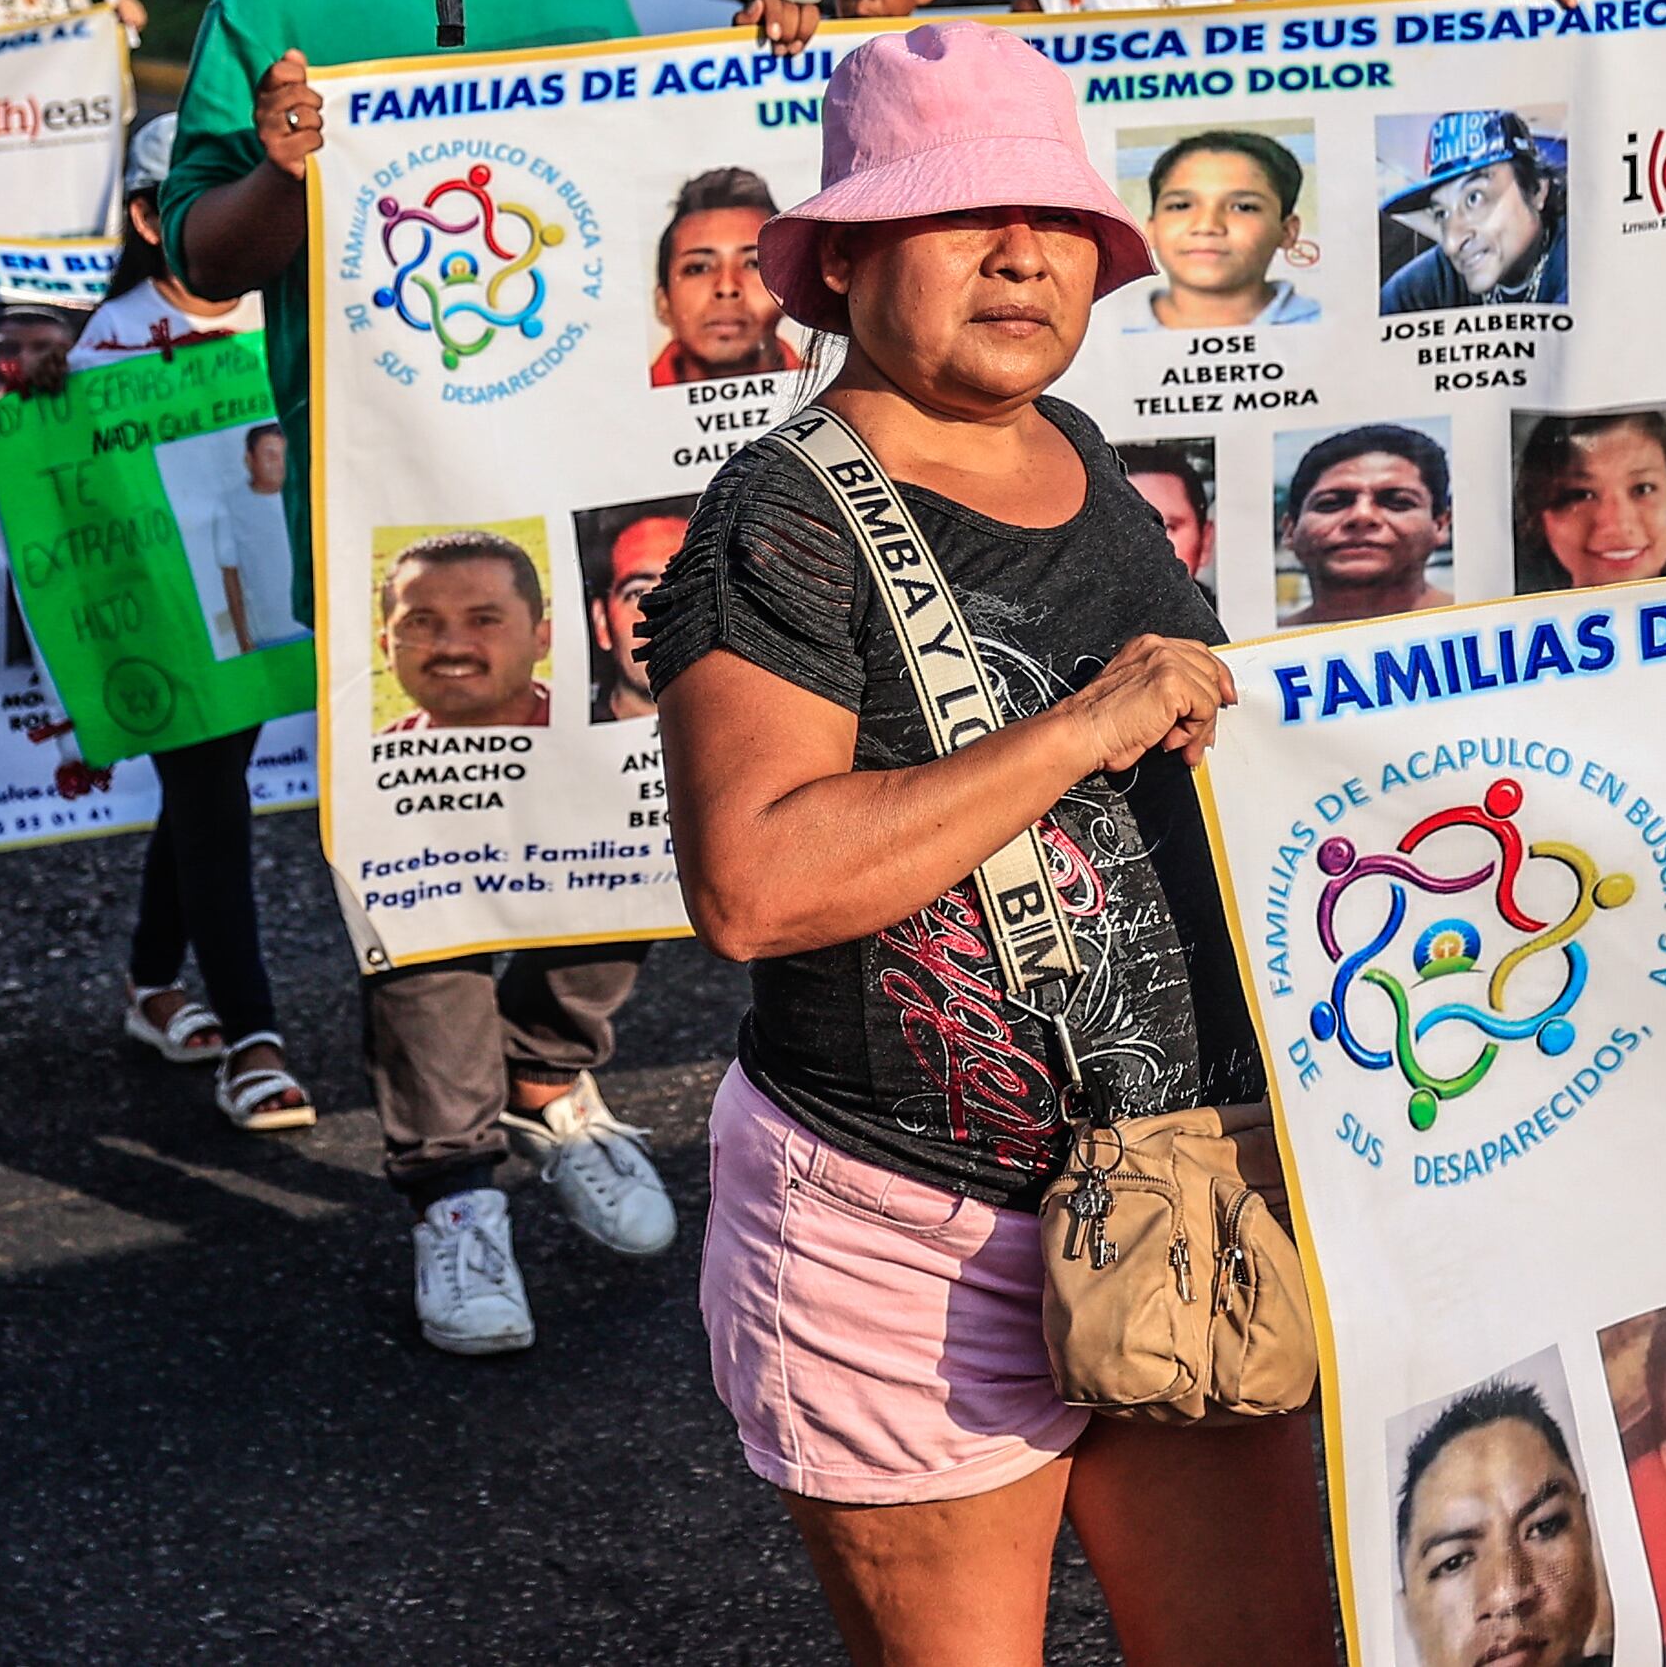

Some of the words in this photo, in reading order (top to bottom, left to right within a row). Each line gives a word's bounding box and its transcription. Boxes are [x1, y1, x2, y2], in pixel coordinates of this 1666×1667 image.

[350, 74, 565, 125] FAMILIAS
[582, 68, 637, 102] DE
[1205, 25, 1264, 55] DE
[1282, 18, 1377, 50] SUS
[1086, 71, 1233, 103] MISMO
[1248, 63, 1392, 94] DOLOR
[340, 185, 376, 280] FAMILIAS
[372, 159, 405, 189] DE
[408, 139, 526, 170] ACAPULCO
[533, 157, 560, 184] EN
[1381, 319, 1445, 343] JOSE
[1453, 313, 1574, 336] ALBERTO
[1188, 336, 1256, 356] JOSE
[1418, 341, 1534, 366] BELTRAN
[687, 378, 776, 405] EDGAR
[1161, 363, 1284, 386] ALBERTO
[1434, 369, 1527, 393] ROSAS
[696, 408, 771, 432] VELEZ
[1134, 394, 1223, 417] TELLEZ
[1233, 389, 1319, 411] MORA
[826, 459, 938, 619] BIMBA
[917, 620, 965, 659] Y
[1274, 614, 1615, 722] FAMILIAS
[371, 735, 533, 764] FERNANDO
[1378, 737, 1573, 794] ACAPULCO
[377, 763, 526, 790] CAMACHO
[1578, 760, 1626, 807] EN
[395, 791, 505, 816] GARCIA
[1314, 776, 1372, 825] DE
[524, 840, 651, 863] Familias
[365, 878, 462, 912] Pagina
[1265, 819, 1318, 1000] FAMILIAS
[1287, 1038, 1324, 1090] DE
[1413, 1024, 1654, 1187] DESAPARECIDOS,
[1335, 1112, 1385, 1168] SUS
